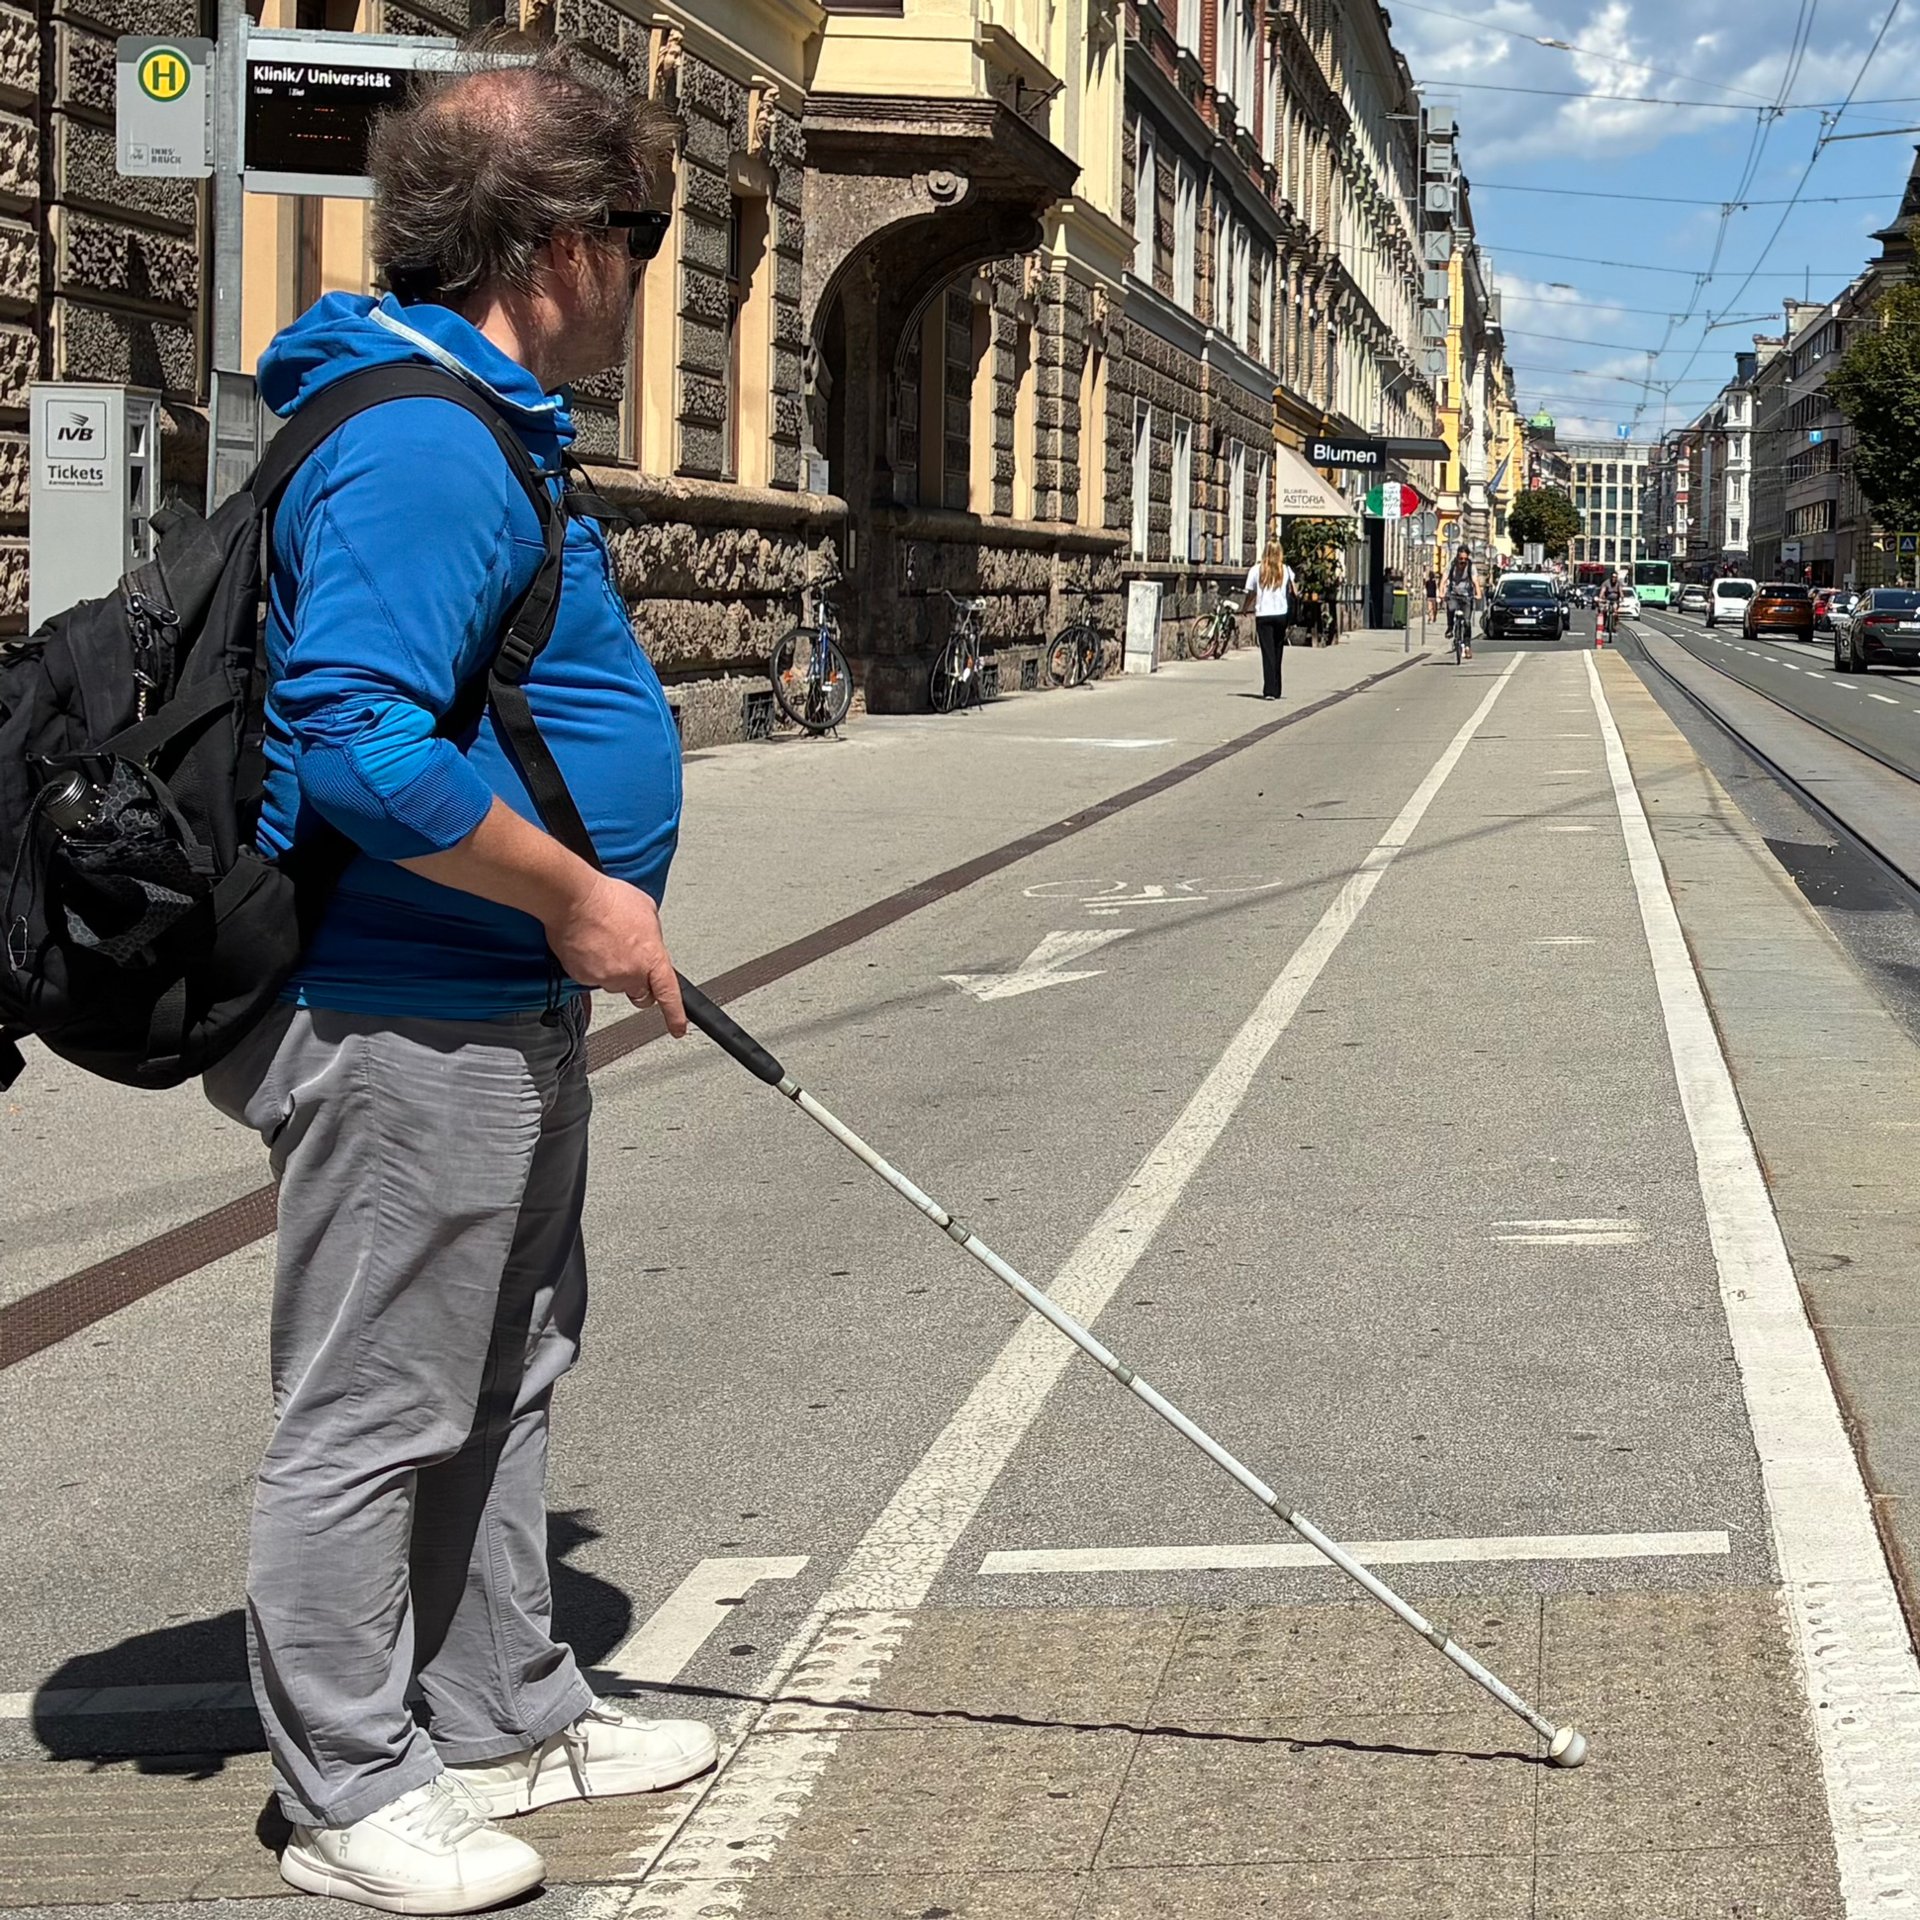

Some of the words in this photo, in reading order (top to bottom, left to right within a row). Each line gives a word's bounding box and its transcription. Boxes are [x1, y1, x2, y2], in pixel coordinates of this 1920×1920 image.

[152, 60, 176, 91] H
[253, 65, 305, 83] Klinik/
[307, 68, 392, 88] Universität
[1426, 232, 1447, 374] KINO
[57, 427, 95, 441] IVB
[1313, 443, 1377, 463] Blumen
[47, 464, 104, 480] Tickets
[1283, 494, 1326, 505] ASTORIA
